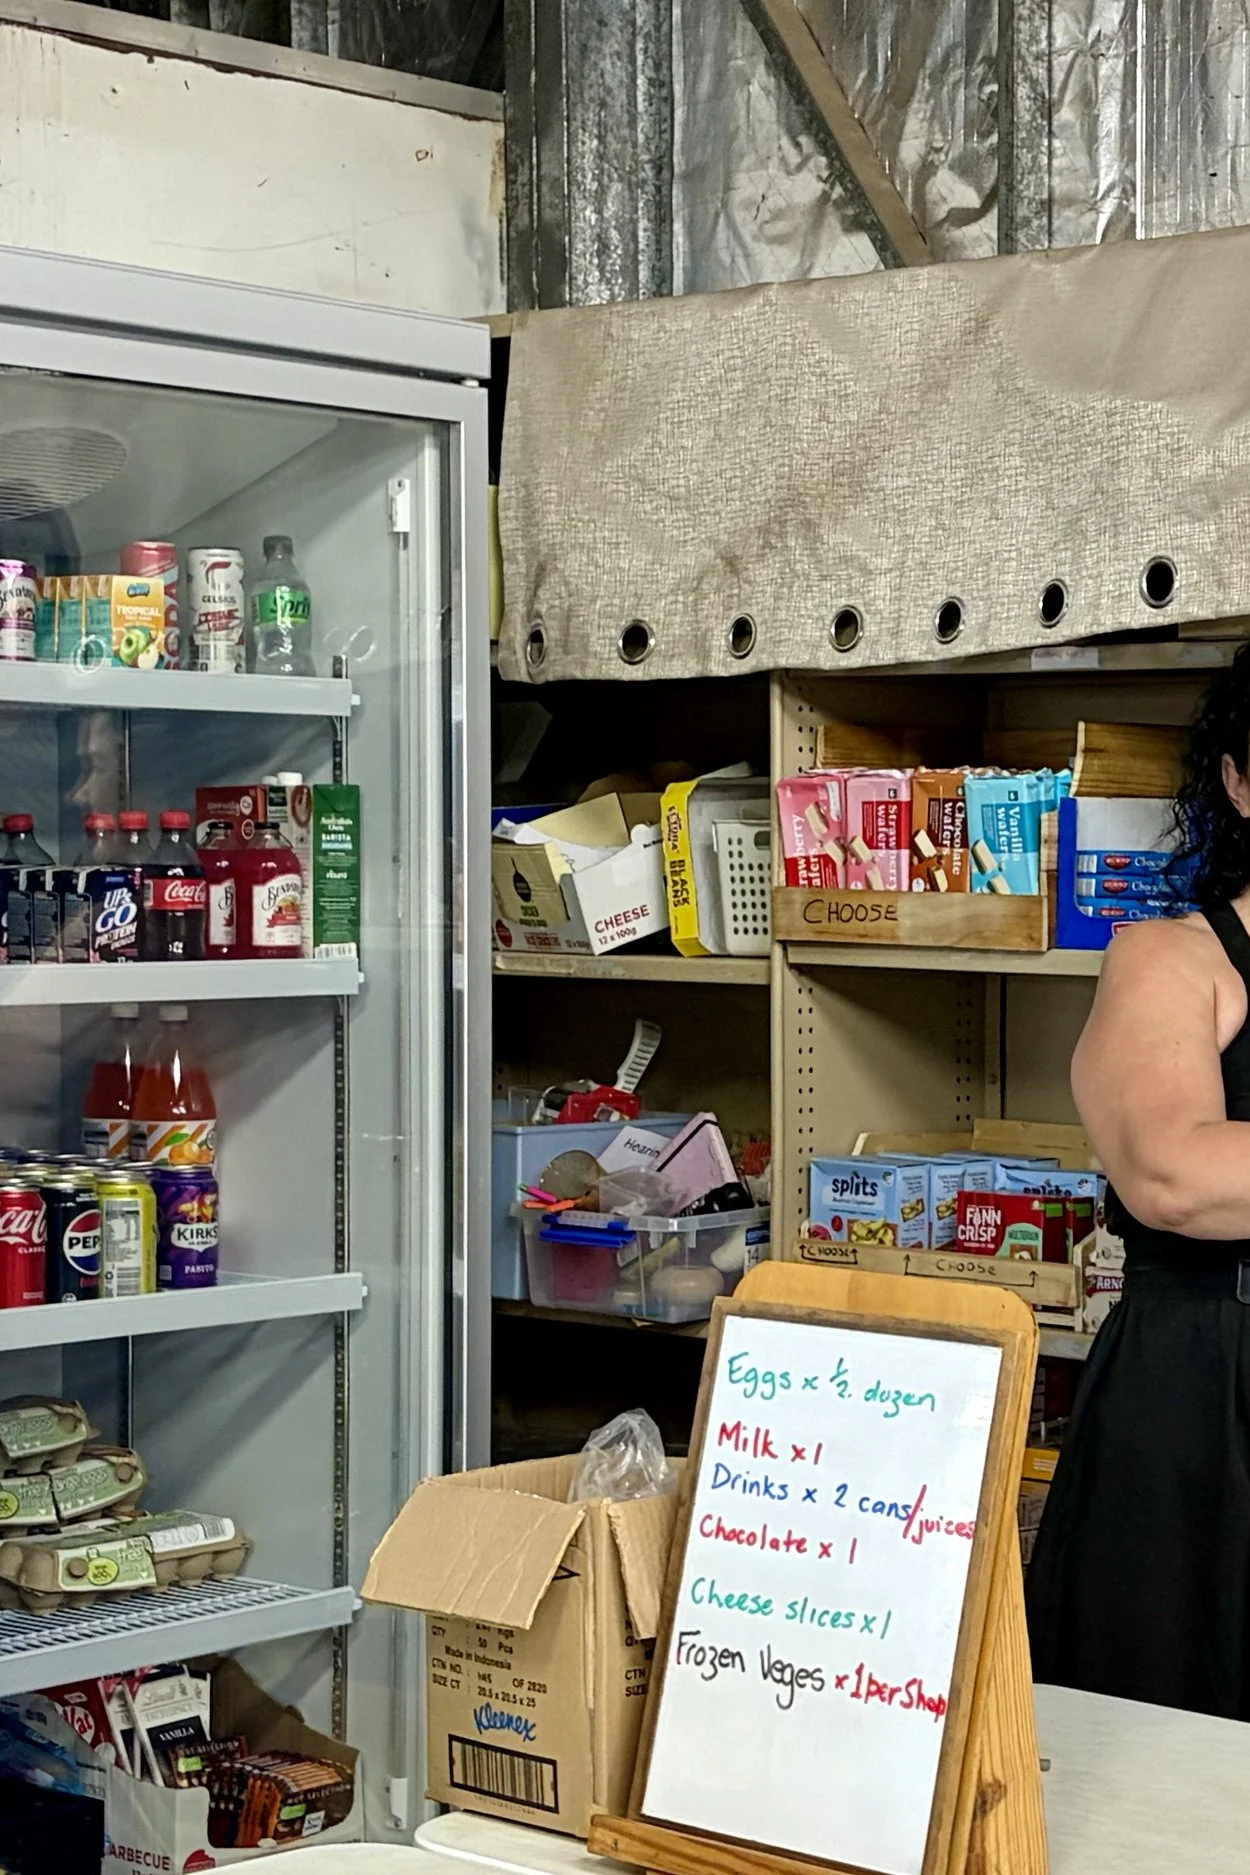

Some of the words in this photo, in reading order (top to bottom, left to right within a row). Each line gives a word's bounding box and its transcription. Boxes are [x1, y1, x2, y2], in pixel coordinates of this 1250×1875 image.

[116, 605, 162, 616] TROPICAL
[942, 802, 955, 856] wafers
[952, 801, 966, 876] Chocolate
[1008, 806, 1024, 862] Vanilla
[669, 860, 681, 908] BEANS
[677, 859, 691, 906] BLACK
[95, 902, 138, 934] GO
[593, 904, 651, 934] CHEESE
[803, 898, 899, 924] CHOOSE
[94, 920, 138, 950] PROTEIN
[598, 936, 609, 946] 12
[616, 926, 638, 942] 100g
[831, 1173, 879, 1198] splits
[965, 1206, 1002, 1228] FINN
[177, 1225, 218, 1242] KIRKS
[957, 1224, 997, 1244] CRISP
[728, 1352, 792, 1400] Eggs
[802, 1374, 819, 1391] x
[863, 1381, 937, 1418] dozen
[717, 1421, 779, 1460] Milk
[711, 1463, 789, 1501] Drinks
[802, 1486, 817, 1504] x
[834, 1483, 850, 1508] 2
[700, 1514, 808, 1555] Chocolate
[818, 1541, 832, 1560] x
[690, 1577, 774, 1617] Cheese
[785, 1597, 855, 1630] slices
[431, 1657, 447, 1671] CTN
[512, 1677, 525, 1689] OF
[444, 1644, 464, 1658] Made
[474, 1653, 511, 1671] Indonesia
[676, 1630, 745, 1682] Frozen
[760, 1645, 826, 1710] Veges
[431, 1673, 448, 1688] SIZE
[449, 1678, 461, 1690] CT
[624, 1667, 646, 1681] CTN
[159, 1726, 195, 1741] VANILLA
[473, 1702, 537, 1743] Kleenex
